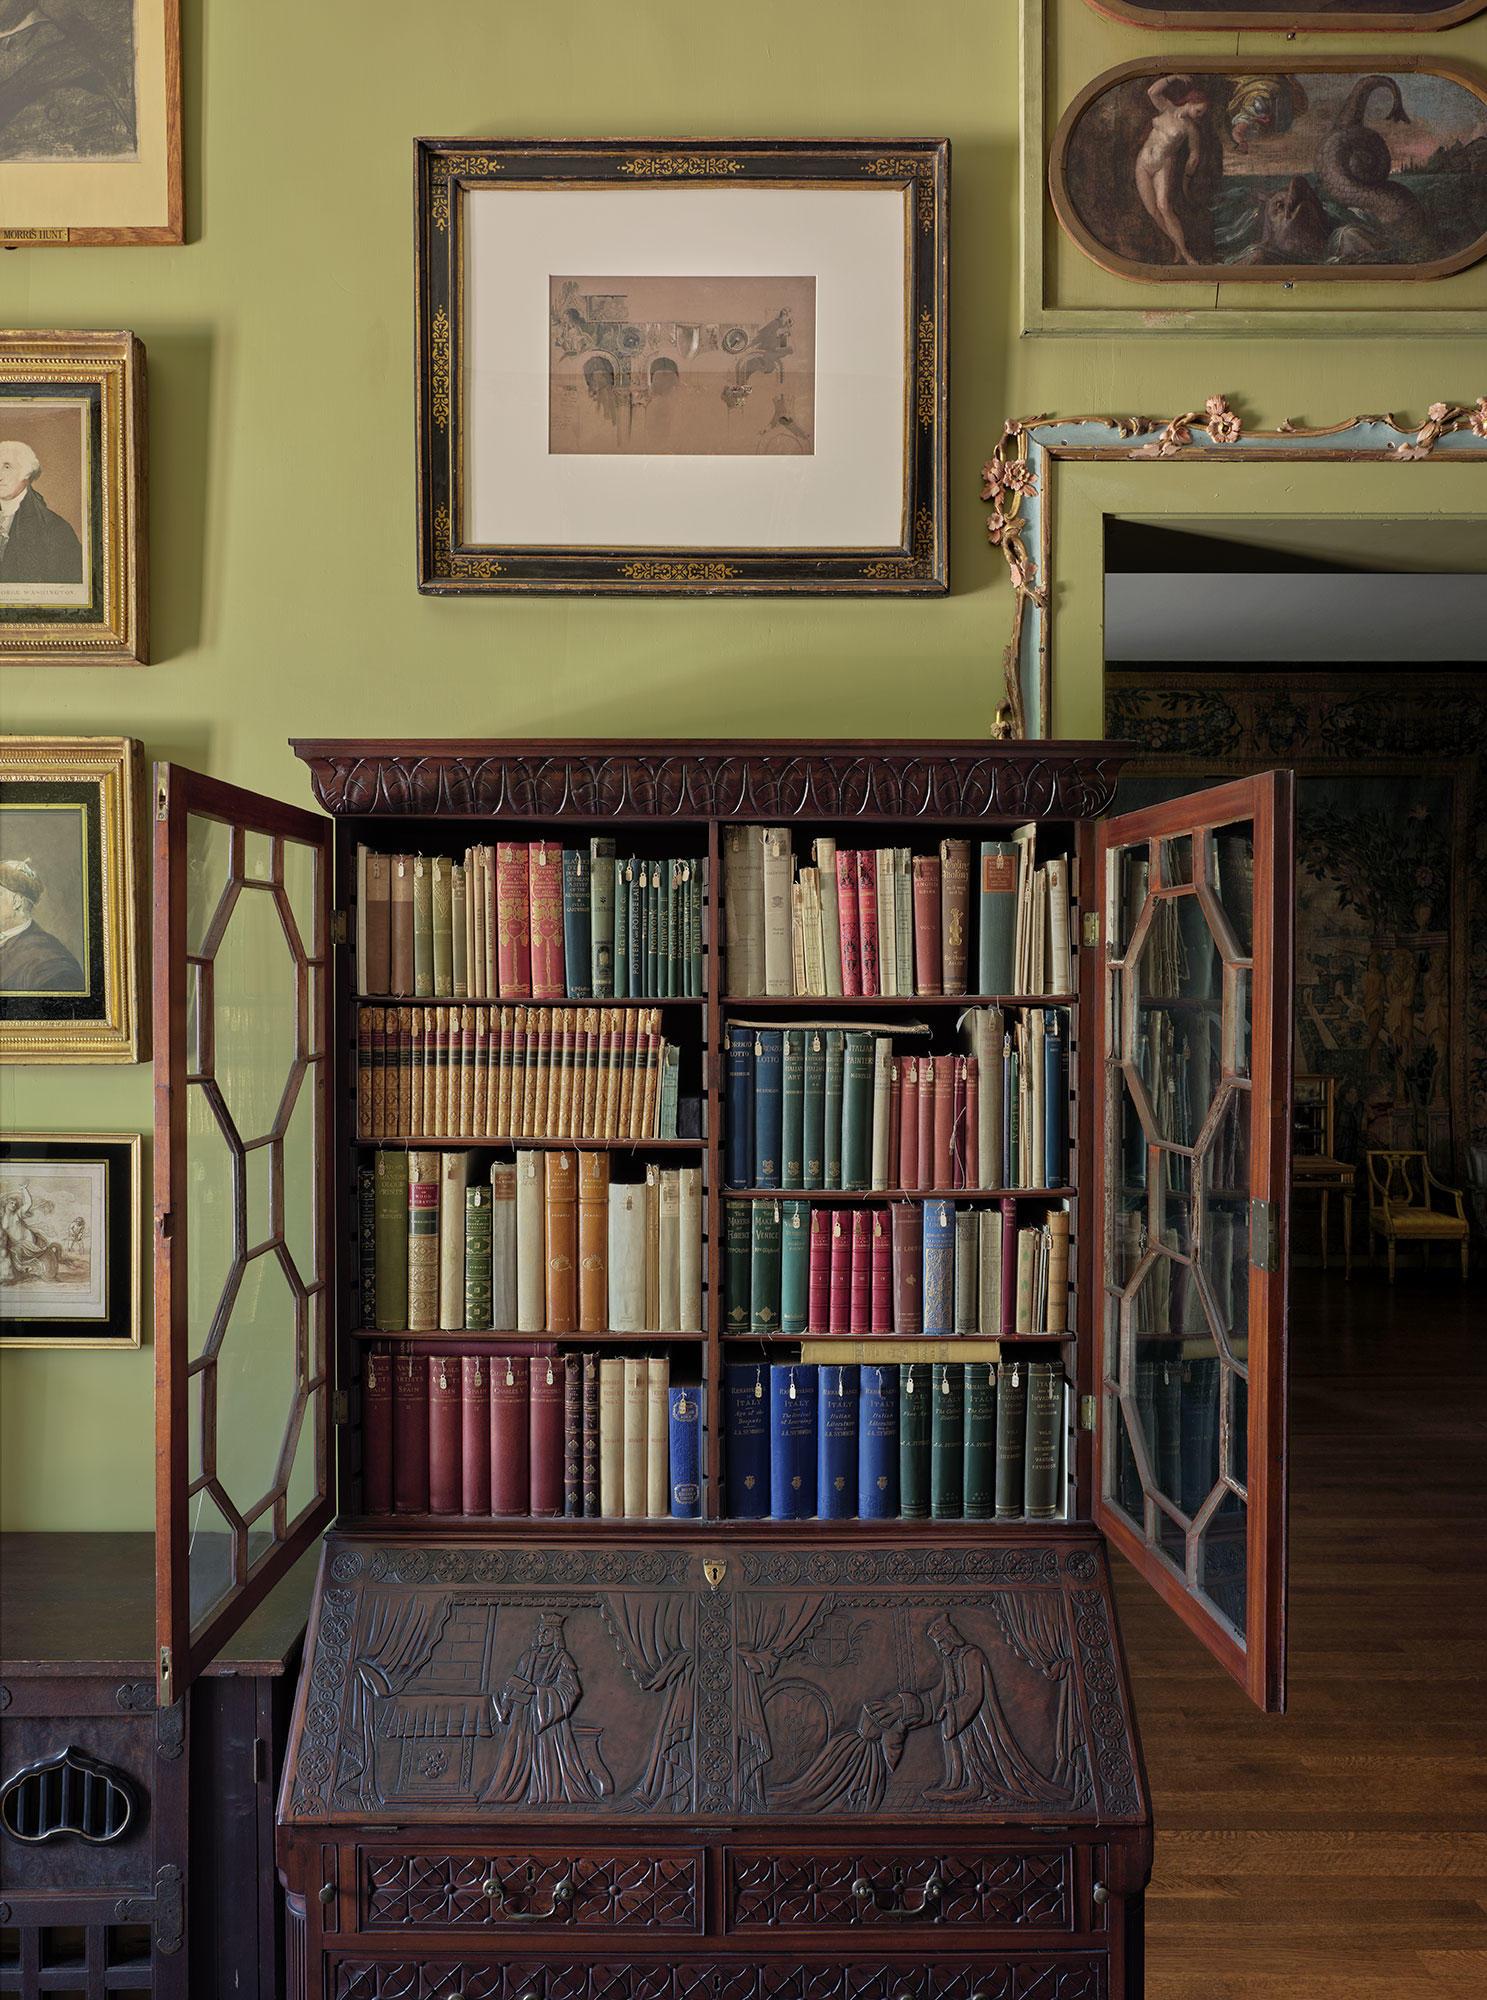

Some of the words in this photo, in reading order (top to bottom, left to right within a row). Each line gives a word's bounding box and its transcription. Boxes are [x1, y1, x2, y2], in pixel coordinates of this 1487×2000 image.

[4, 230, 37, 240] MORRIS
[40, 230, 63, 240] HUNT
[632, 881, 640, 930] PORCELAIN
[692, 887, 701, 909] Arts
[618, 896, 626, 956] Maiolica
[648, 908, 658, 954] Ironwork
[658, 911, 668, 956] Ironwork
[692, 916, 701, 954] Danish
[632, 938, 640, 975] POTTERY
[757, 1056, 779, 1064] LOTTO
[756, 1229, 779, 1240] VENICE
[737, 1400, 761, 1408] ITALY
[785, 1400, 810, 1408] ITALY
[828, 1400, 853, 1408] ITALY
[870, 1400, 896, 1408] ITALY
